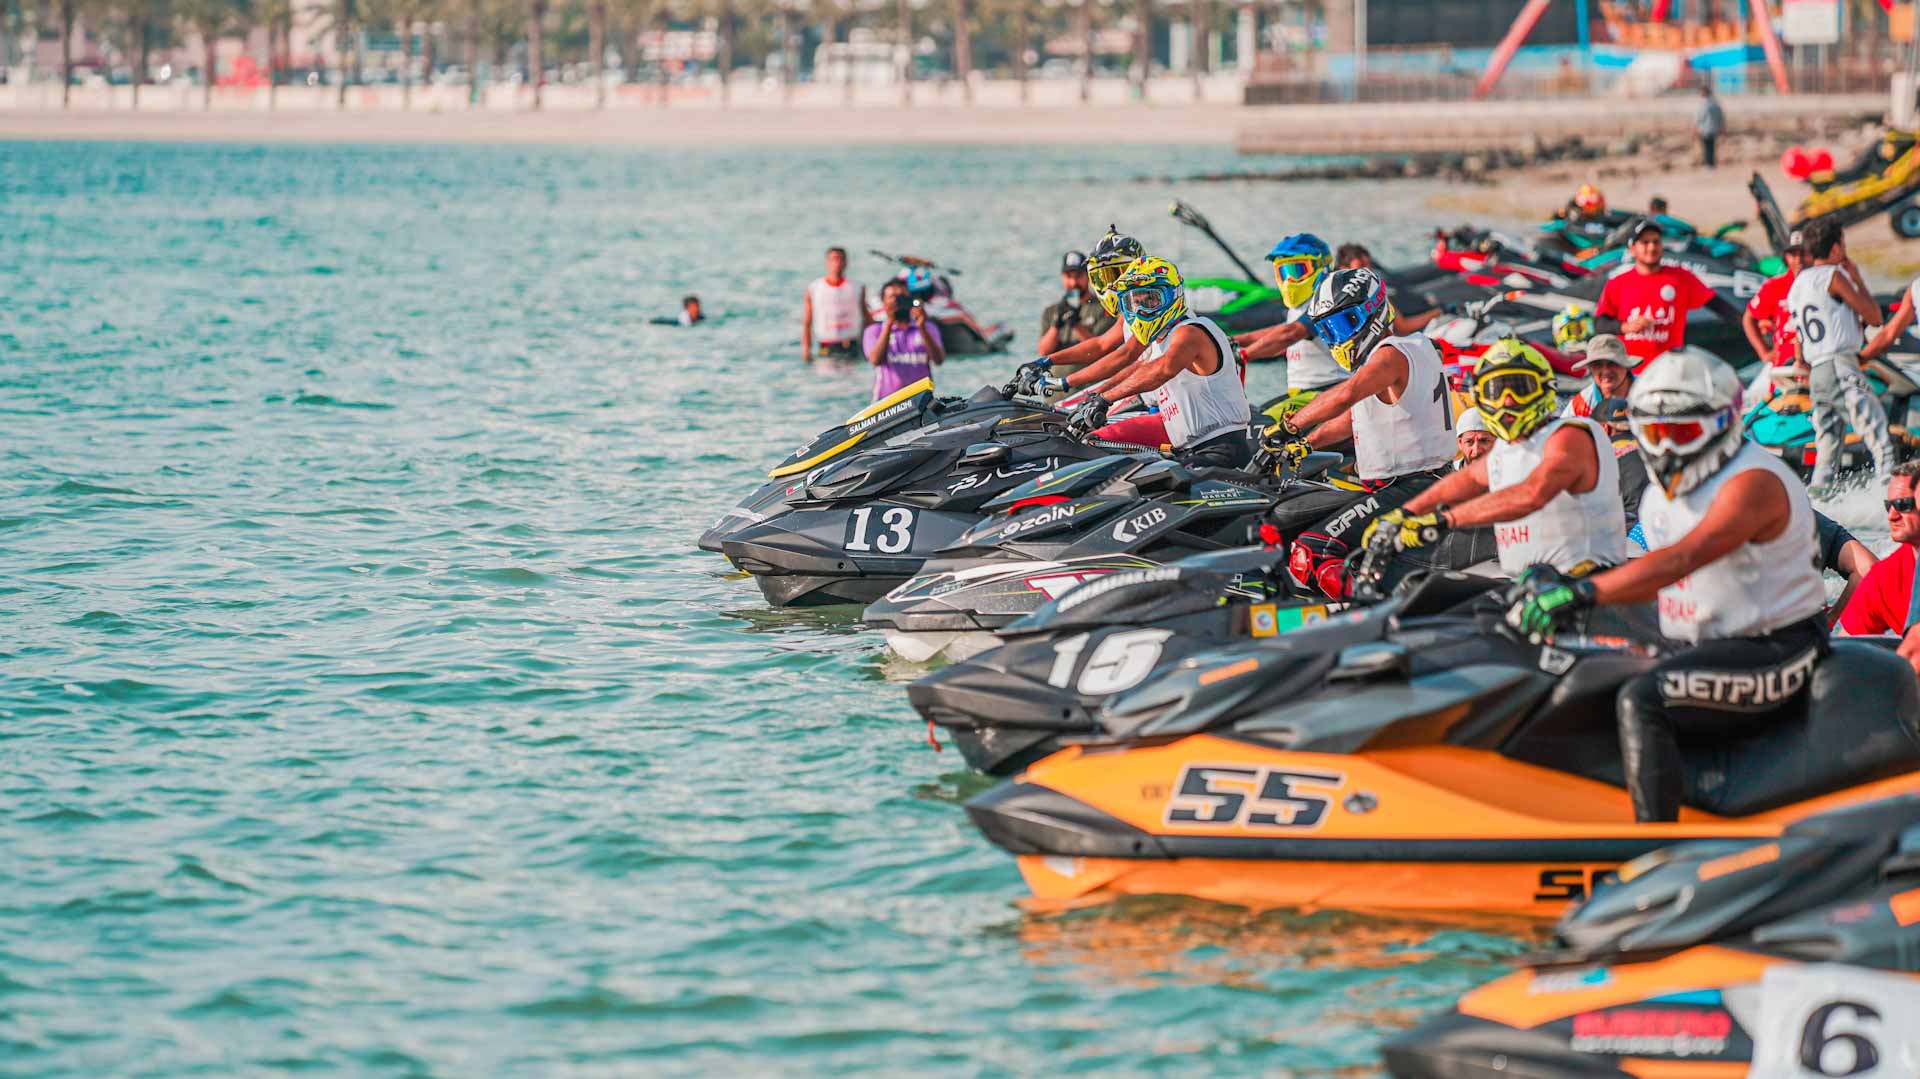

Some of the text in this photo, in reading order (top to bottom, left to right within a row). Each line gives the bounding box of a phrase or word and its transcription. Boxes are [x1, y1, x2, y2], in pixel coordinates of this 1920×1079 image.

[849, 415, 877, 435] SALMAN
[846, 507, 914, 554] 13
[1130, 507, 1167, 534] KIB
[1048, 628, 1176, 696] 15
[1663, 646, 1819, 705] JETPILOT
[1164, 765, 1343, 830] 55
[1800, 1001, 1883, 1077] 6
